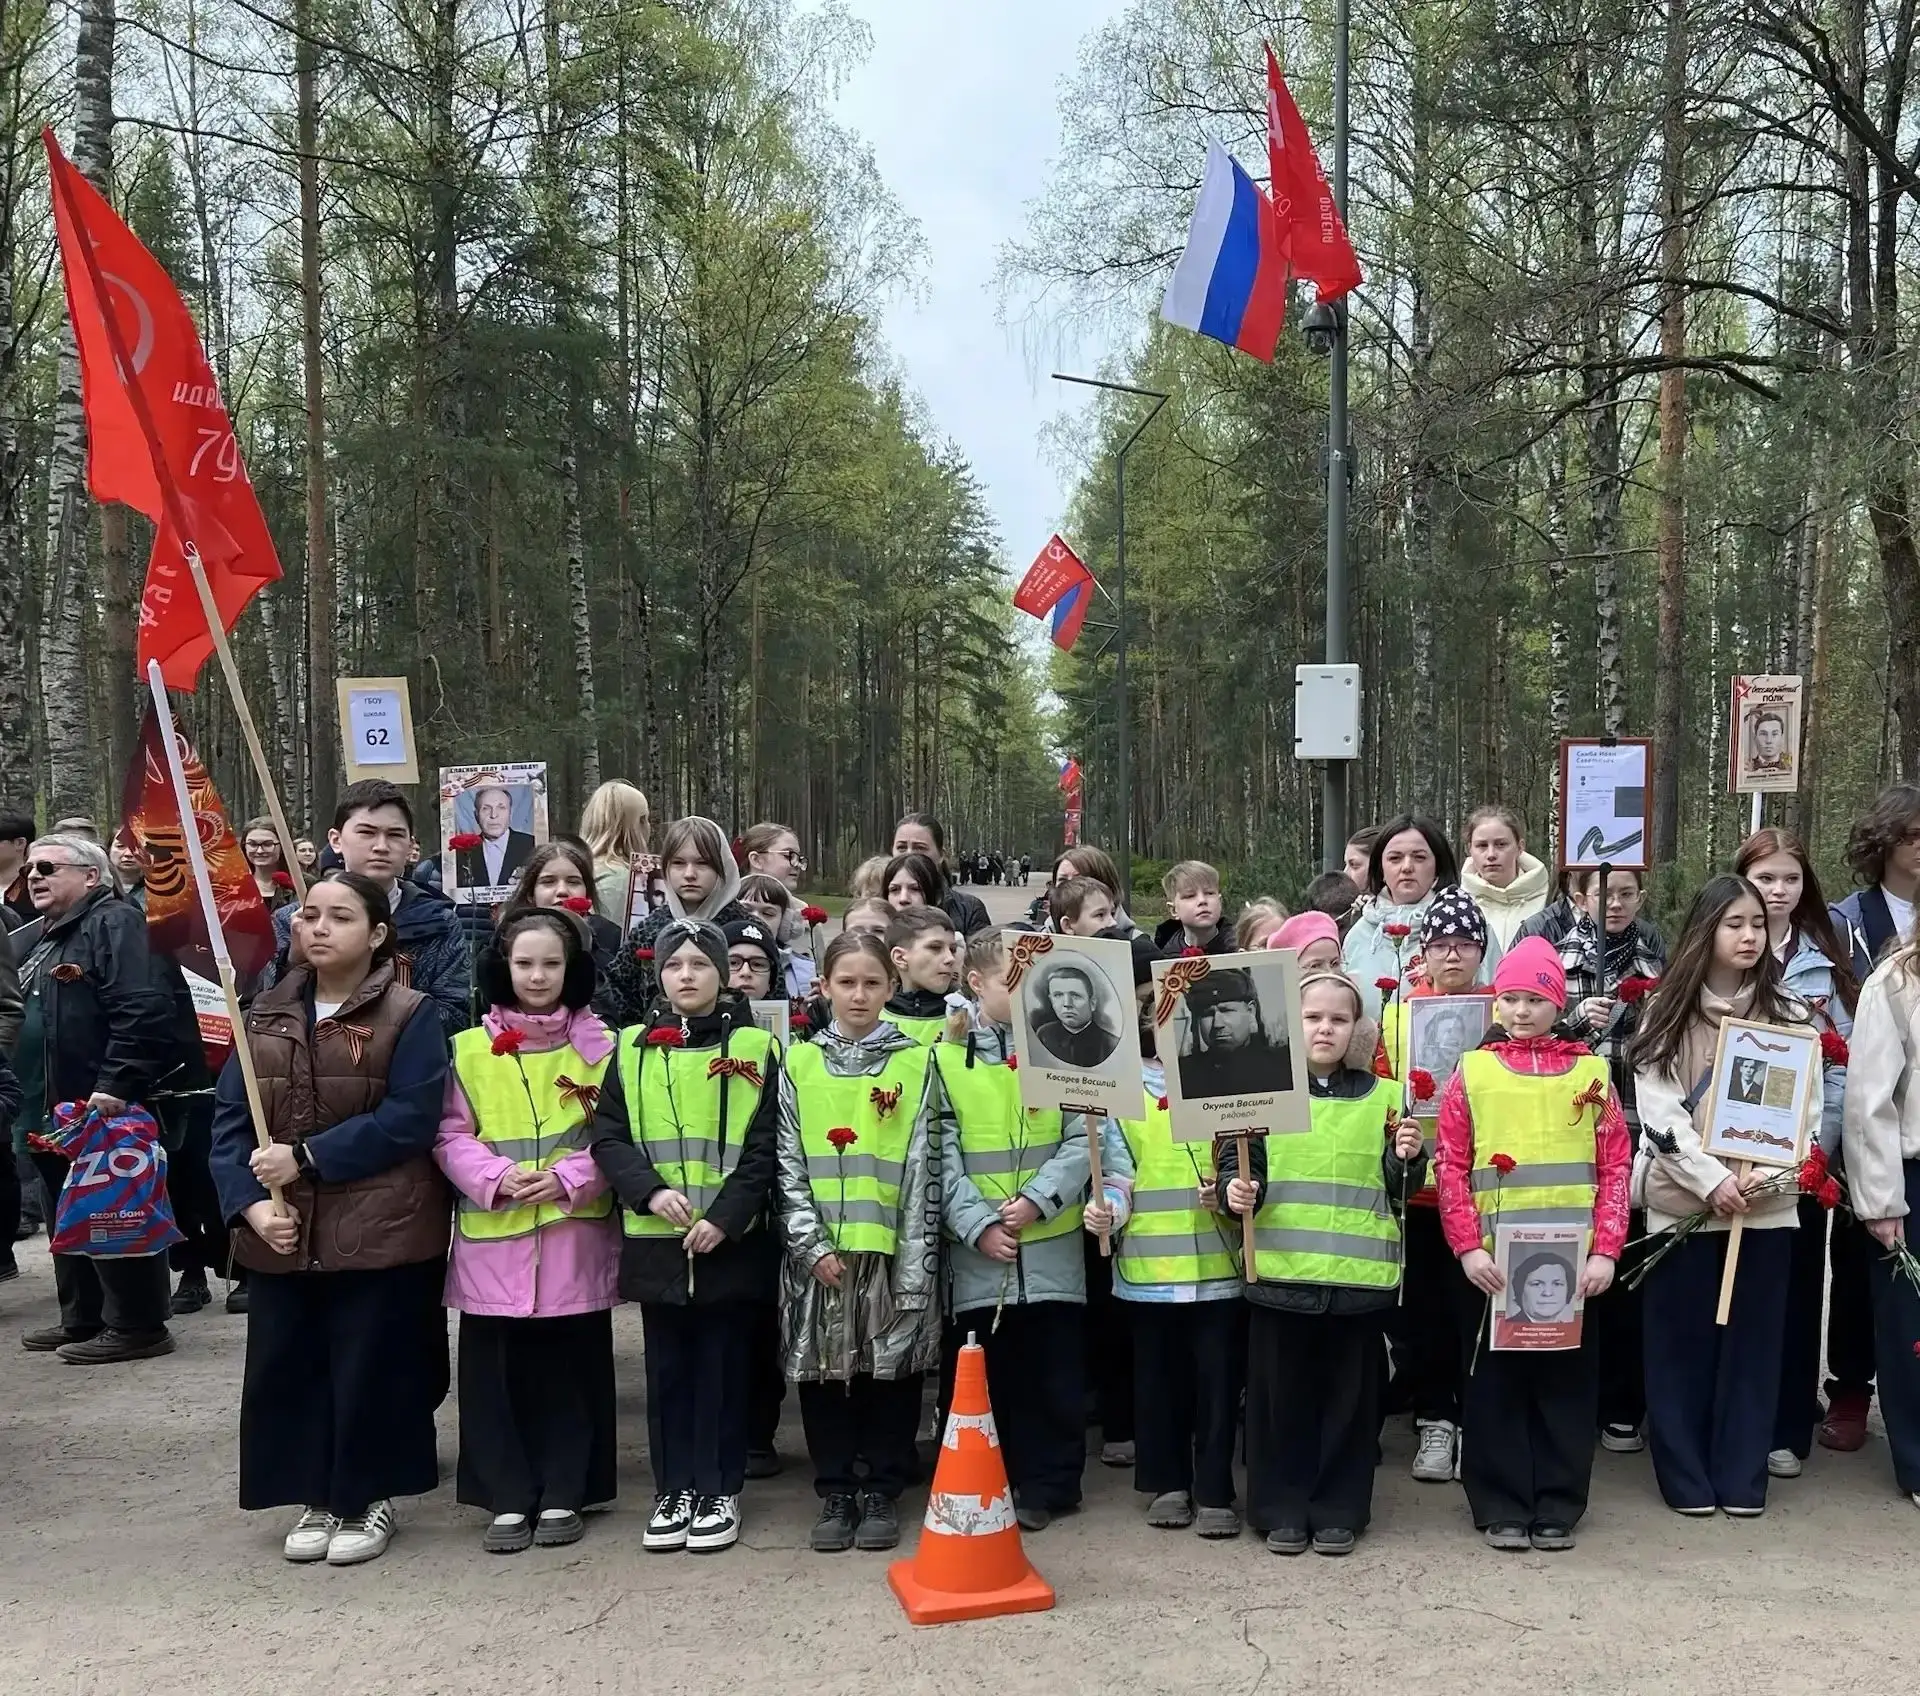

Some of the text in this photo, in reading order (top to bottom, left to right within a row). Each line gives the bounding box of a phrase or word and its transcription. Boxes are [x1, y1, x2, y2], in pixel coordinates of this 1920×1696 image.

[189, 427, 238, 482] 79
[364, 697, 382, 705] ГБОУ
[363, 710, 387, 718] школа
[366, 728, 390, 746] 62
[1082, 1076, 1117, 1088] Василий
[1065, 1087, 1099, 1097] рядовой
[1202, 1097, 1274, 1112] Окунев Василий
[1220, 1110, 1257, 1121] рядовой
[89, 1212, 117, 1220] ozon
